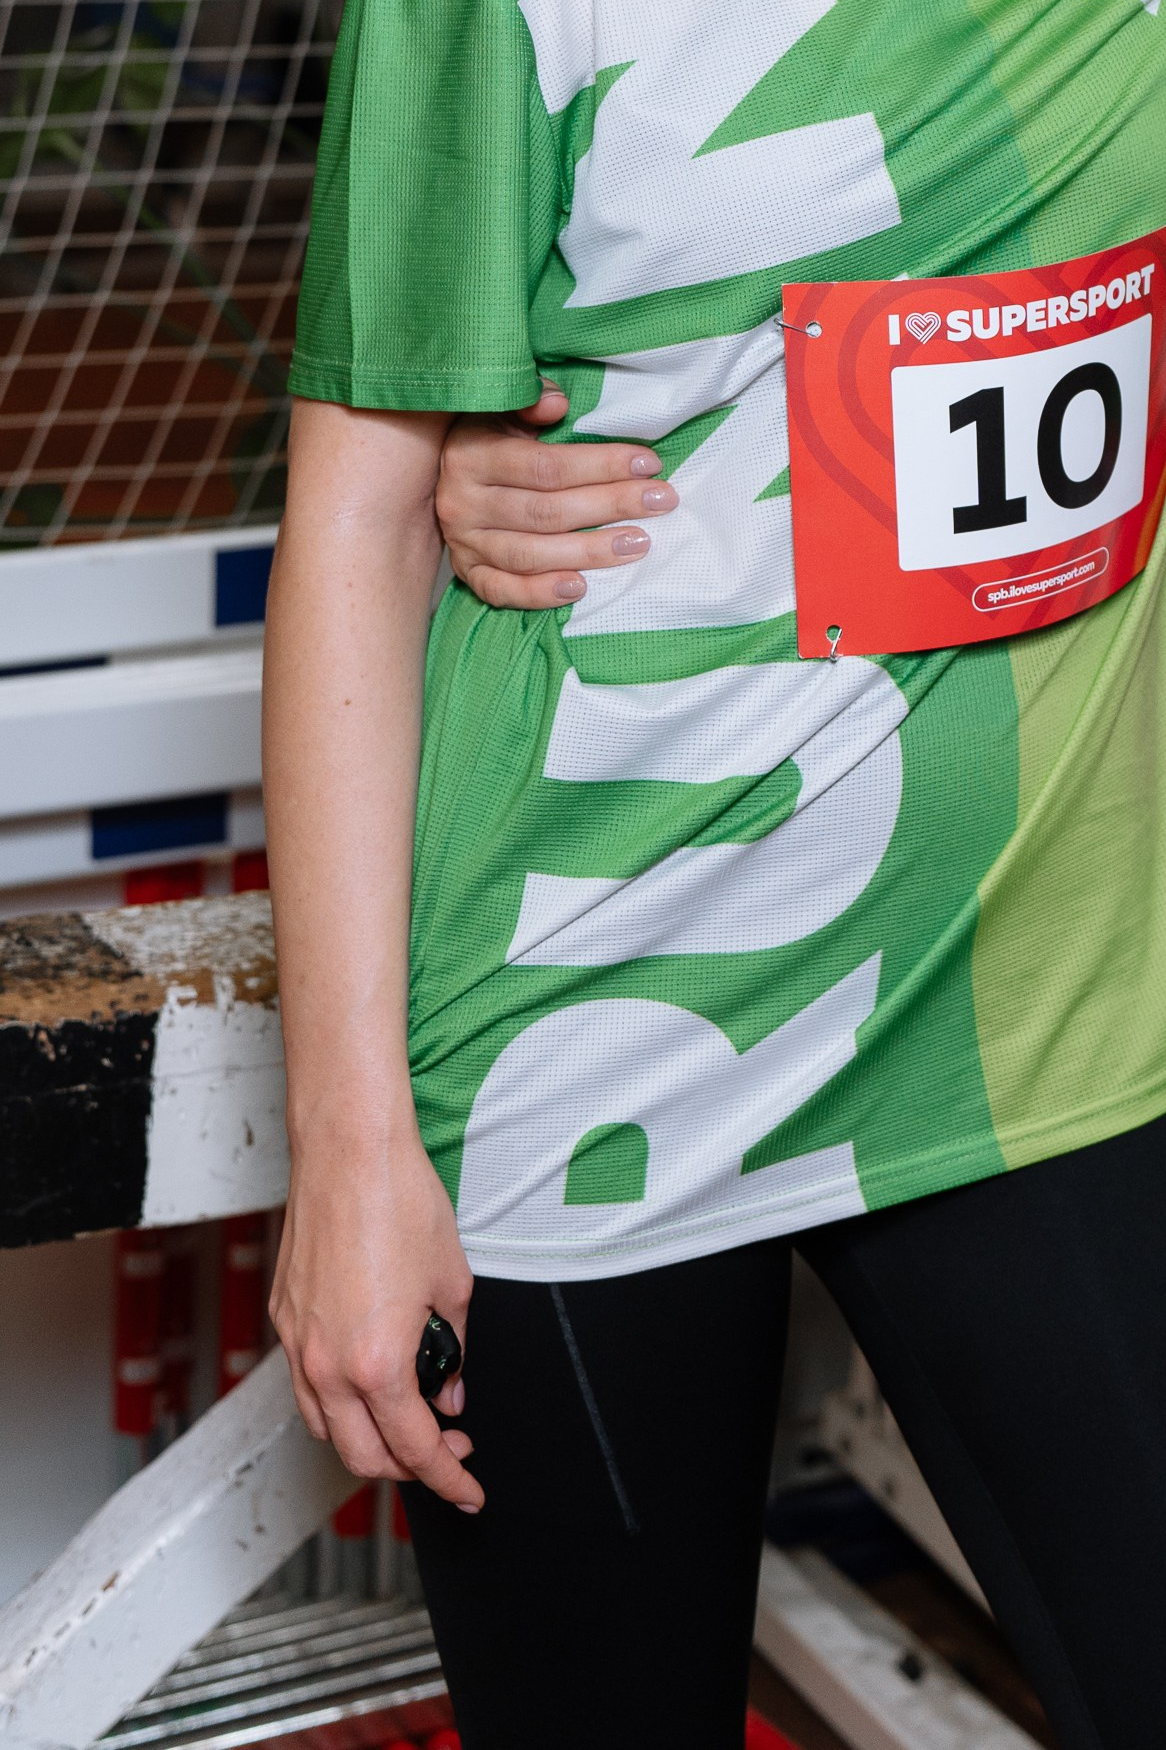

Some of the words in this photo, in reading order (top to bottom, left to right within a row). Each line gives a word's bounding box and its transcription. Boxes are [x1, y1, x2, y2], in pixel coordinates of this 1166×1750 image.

[887, 313, 901, 346] I
[946, 262, 1156, 343] SUPERSPORT
[948, 361, 1123, 535] 10
[986, 561, 1096, 604] spb.ilovesupersport.com
